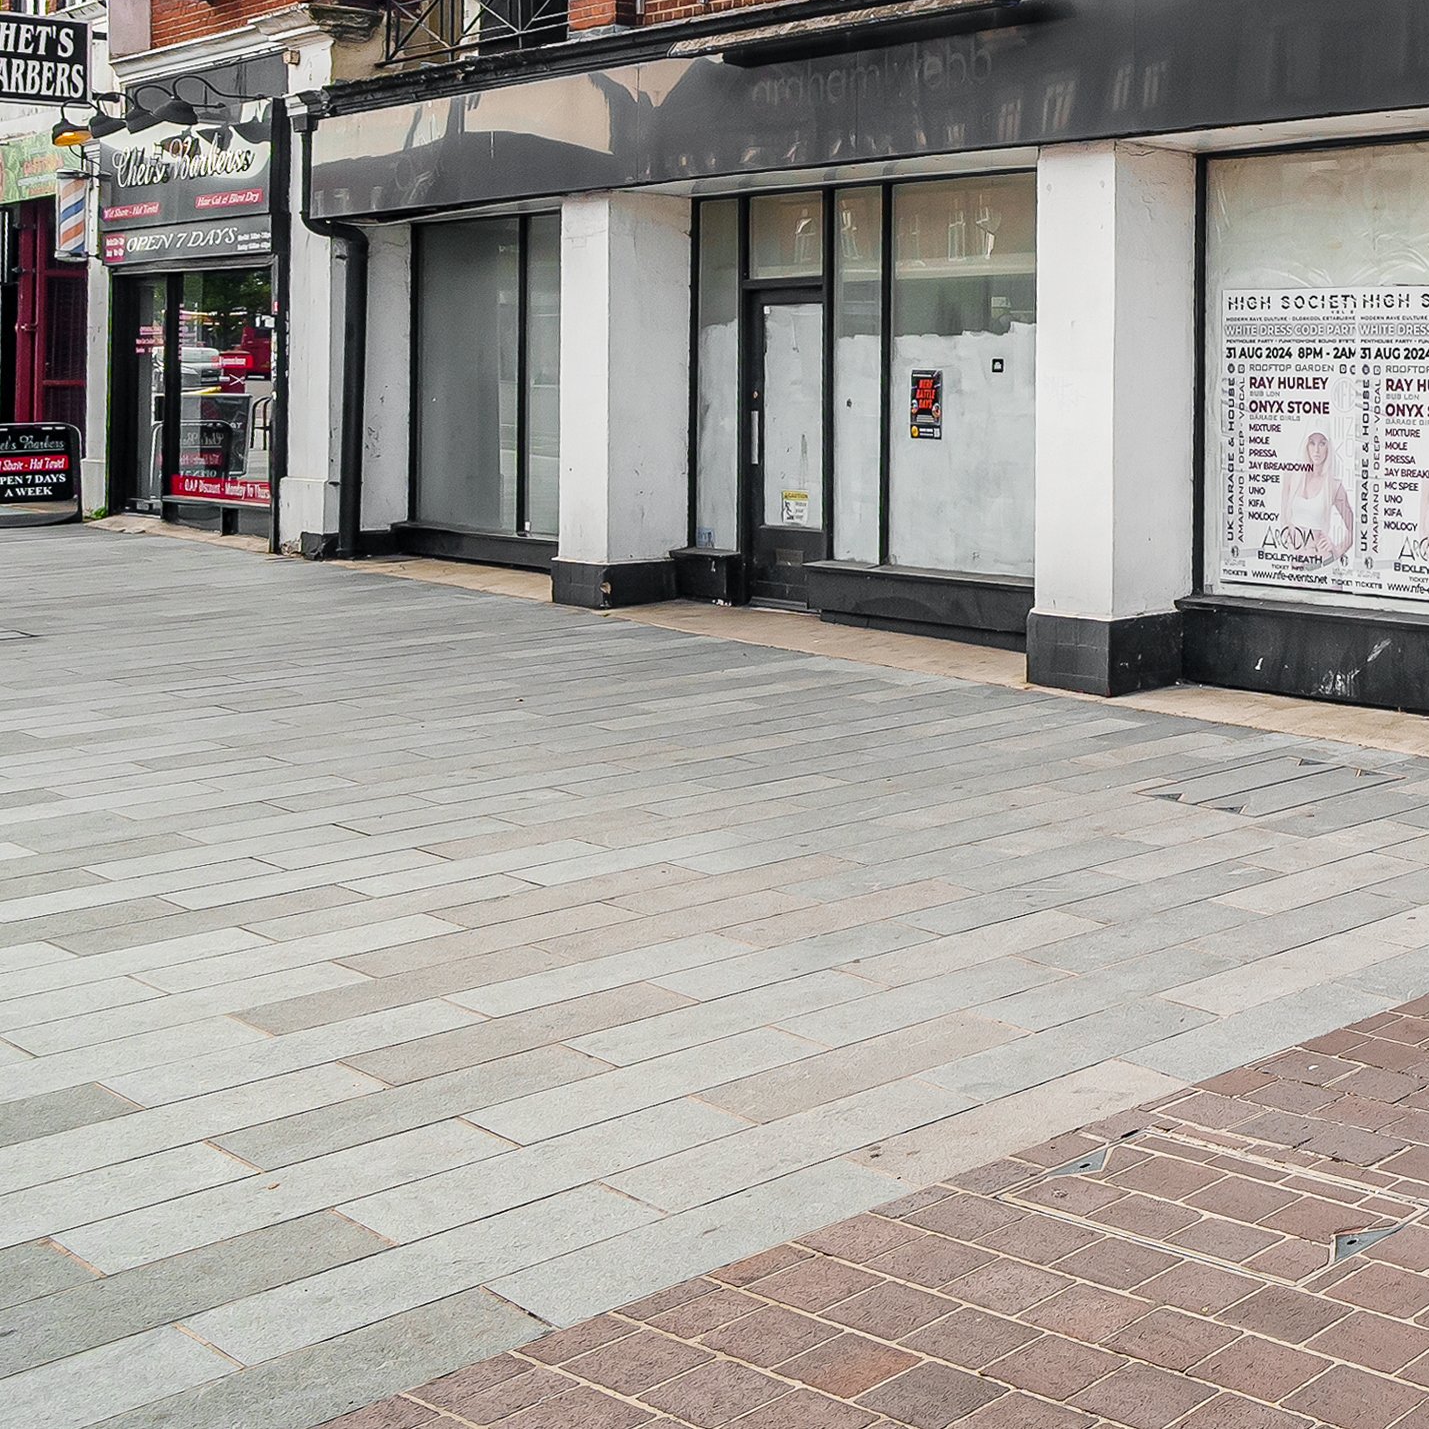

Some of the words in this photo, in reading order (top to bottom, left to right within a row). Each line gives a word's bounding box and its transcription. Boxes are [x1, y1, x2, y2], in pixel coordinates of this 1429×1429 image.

[0, 22, 75, 58] HET'S
[0, 57, 84, 98] ARBERS
[127, 235, 173, 252] OPEN
[175, 233, 186, 248] 7
[187, 228, 238, 247] DAYS
[1228, 296, 1271, 310] HIGH
[1225, 324, 1257, 336] WHITE
[1260, 324, 1293, 336] DRESS
[1294, 324, 1324, 336] CODE
[1359, 324, 1395, 336] WHITE
[1226, 347, 1236, 359] 31
[1238, 347, 1263, 359] AUG
[1265, 347, 1292, 359] 2024
[1298, 347, 1323, 359] 8PM
[1360, 348, 1371, 359] 31
[1374, 348, 1401, 360] AUG
[1249, 377, 1274, 389] RAY
[1278, 377, 1329, 389] HURLEY
[1386, 378, 1413, 391] RAY
[1249, 400, 1284, 414] ONYX
[1287, 401, 1330, 414] STONE
[1385, 403, 1424, 418] ONYX
[1385, 428, 1420, 438] MIXTURE
[0, 475, 23, 485] PEN
[25, 475, 33, 484] 7
[34, 474, 67, 484] DAYS
[4, 489, 14, 497] A
[16, 486, 53, 496] WEEK
